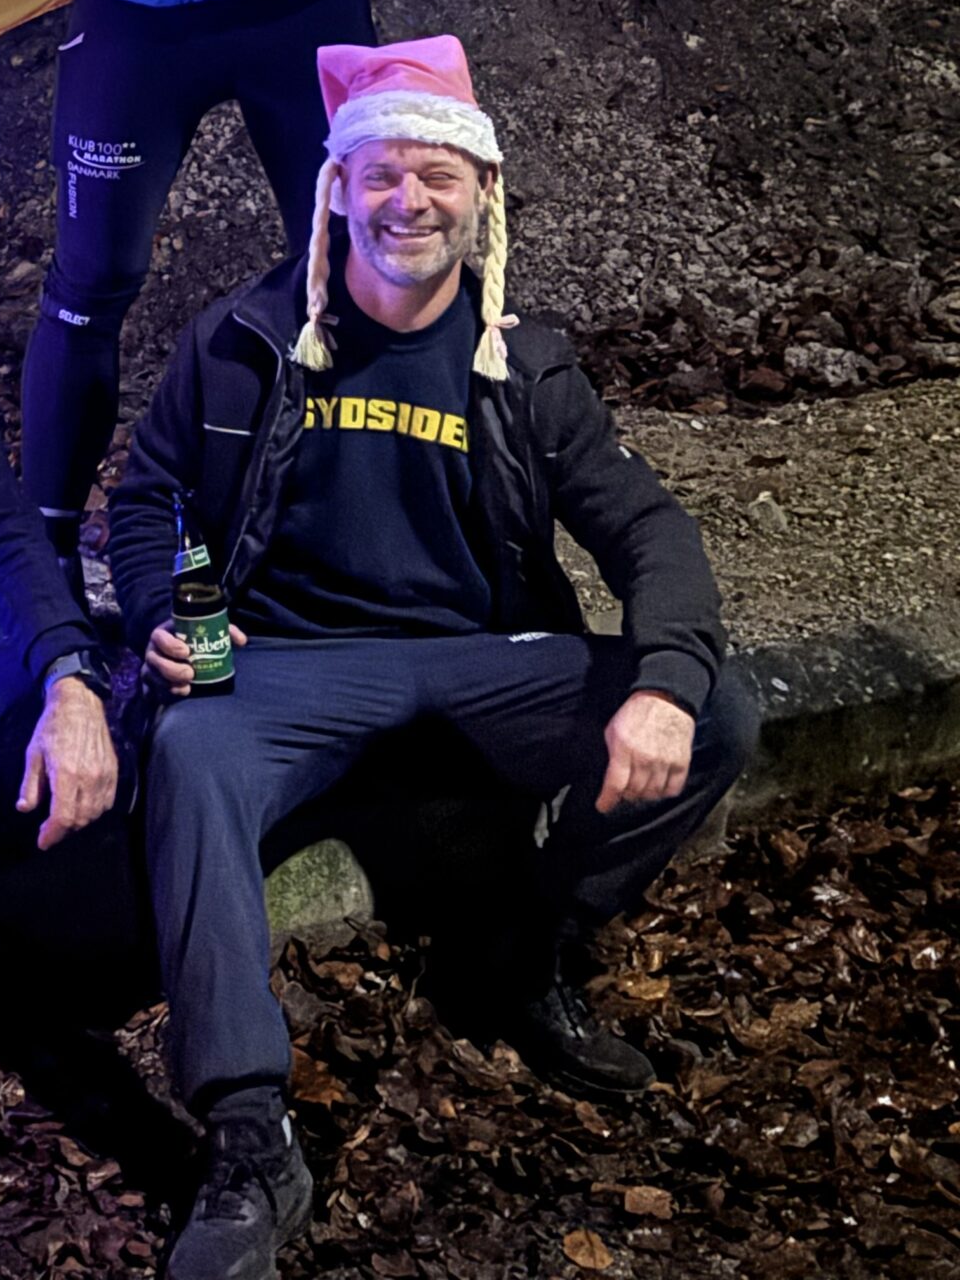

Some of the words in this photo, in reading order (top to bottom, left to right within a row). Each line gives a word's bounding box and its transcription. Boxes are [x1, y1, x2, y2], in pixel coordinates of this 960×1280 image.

[67, 160, 121, 180] DANMARK
[83, 152, 142, 164] MARATHON
[68, 172, 78, 219] FUSION
[304, 397, 469, 453] YDSIDE
